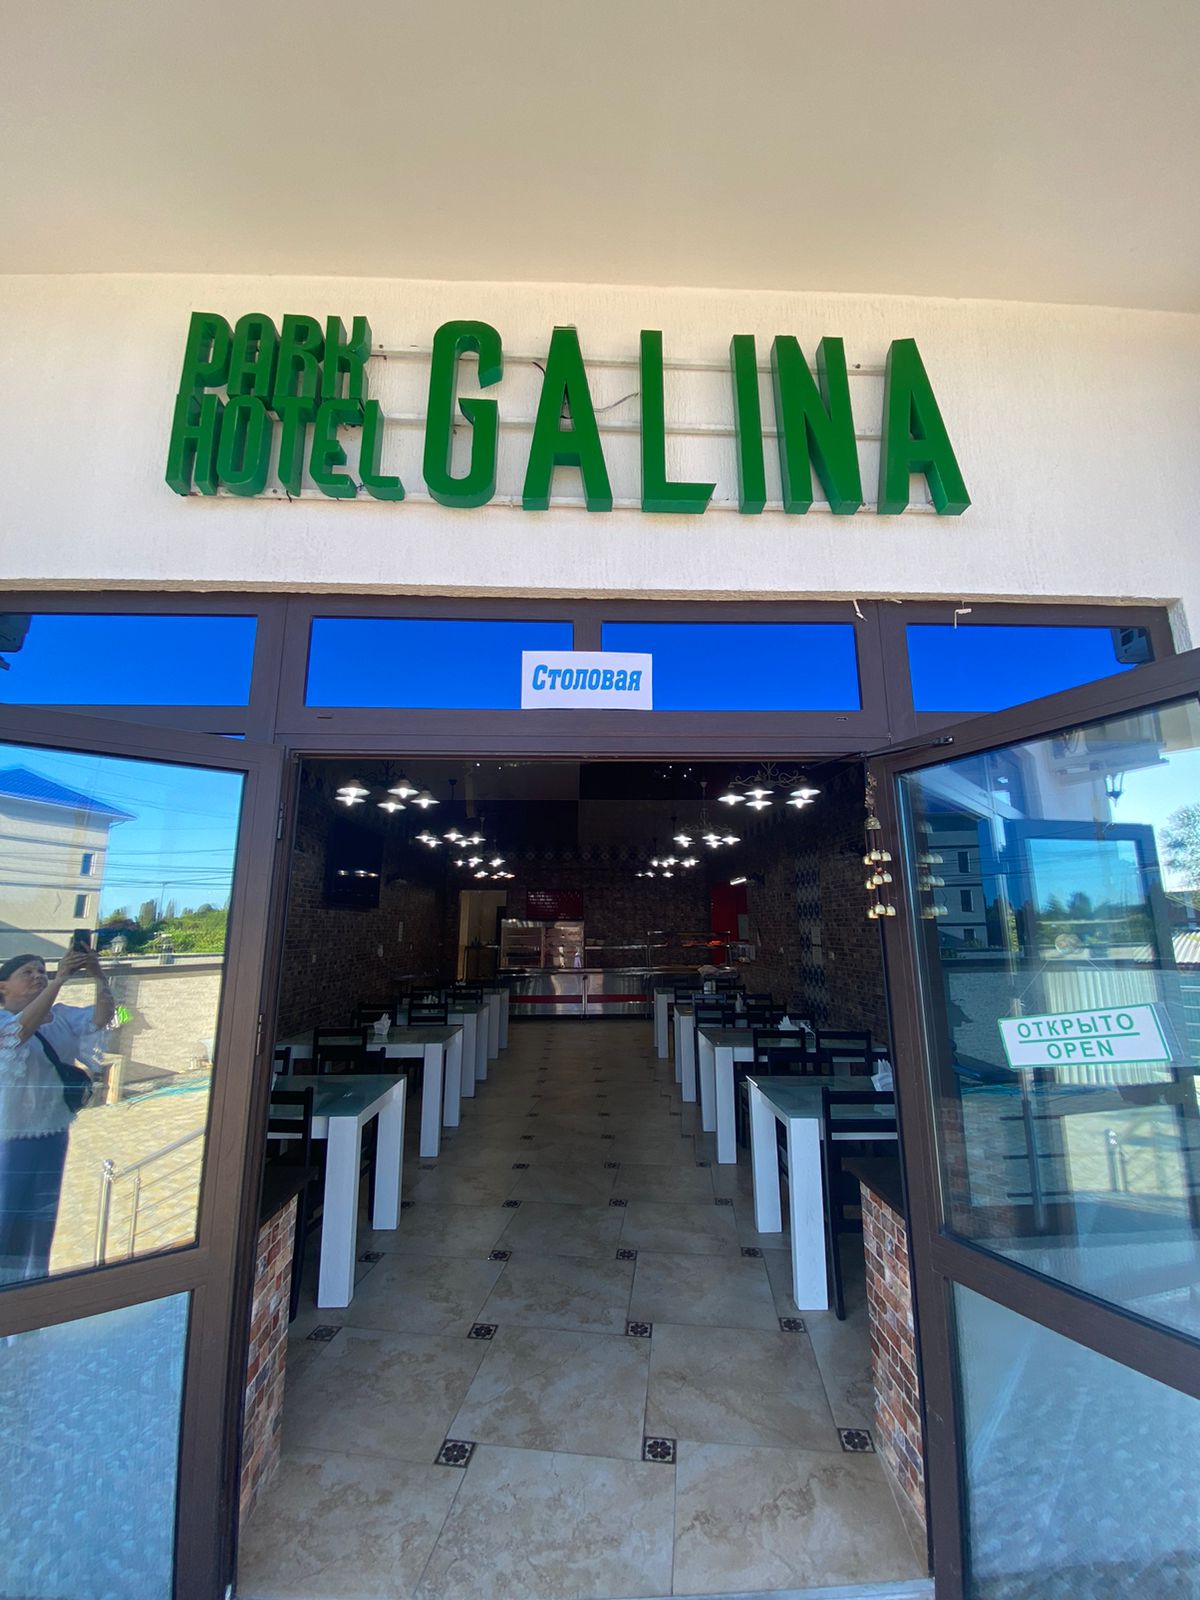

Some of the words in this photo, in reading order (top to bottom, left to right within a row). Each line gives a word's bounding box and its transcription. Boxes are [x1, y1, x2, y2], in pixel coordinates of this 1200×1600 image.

[177, 311, 373, 399] PARK
[422, 319, 972, 516] GALINA
[165, 394, 406, 502] HOTEL
[531, 663, 643, 692] Столовая
[1017, 1013, 1134, 1038] ОТКРЫТО
[1047, 1039, 1114, 1060] OPEN
